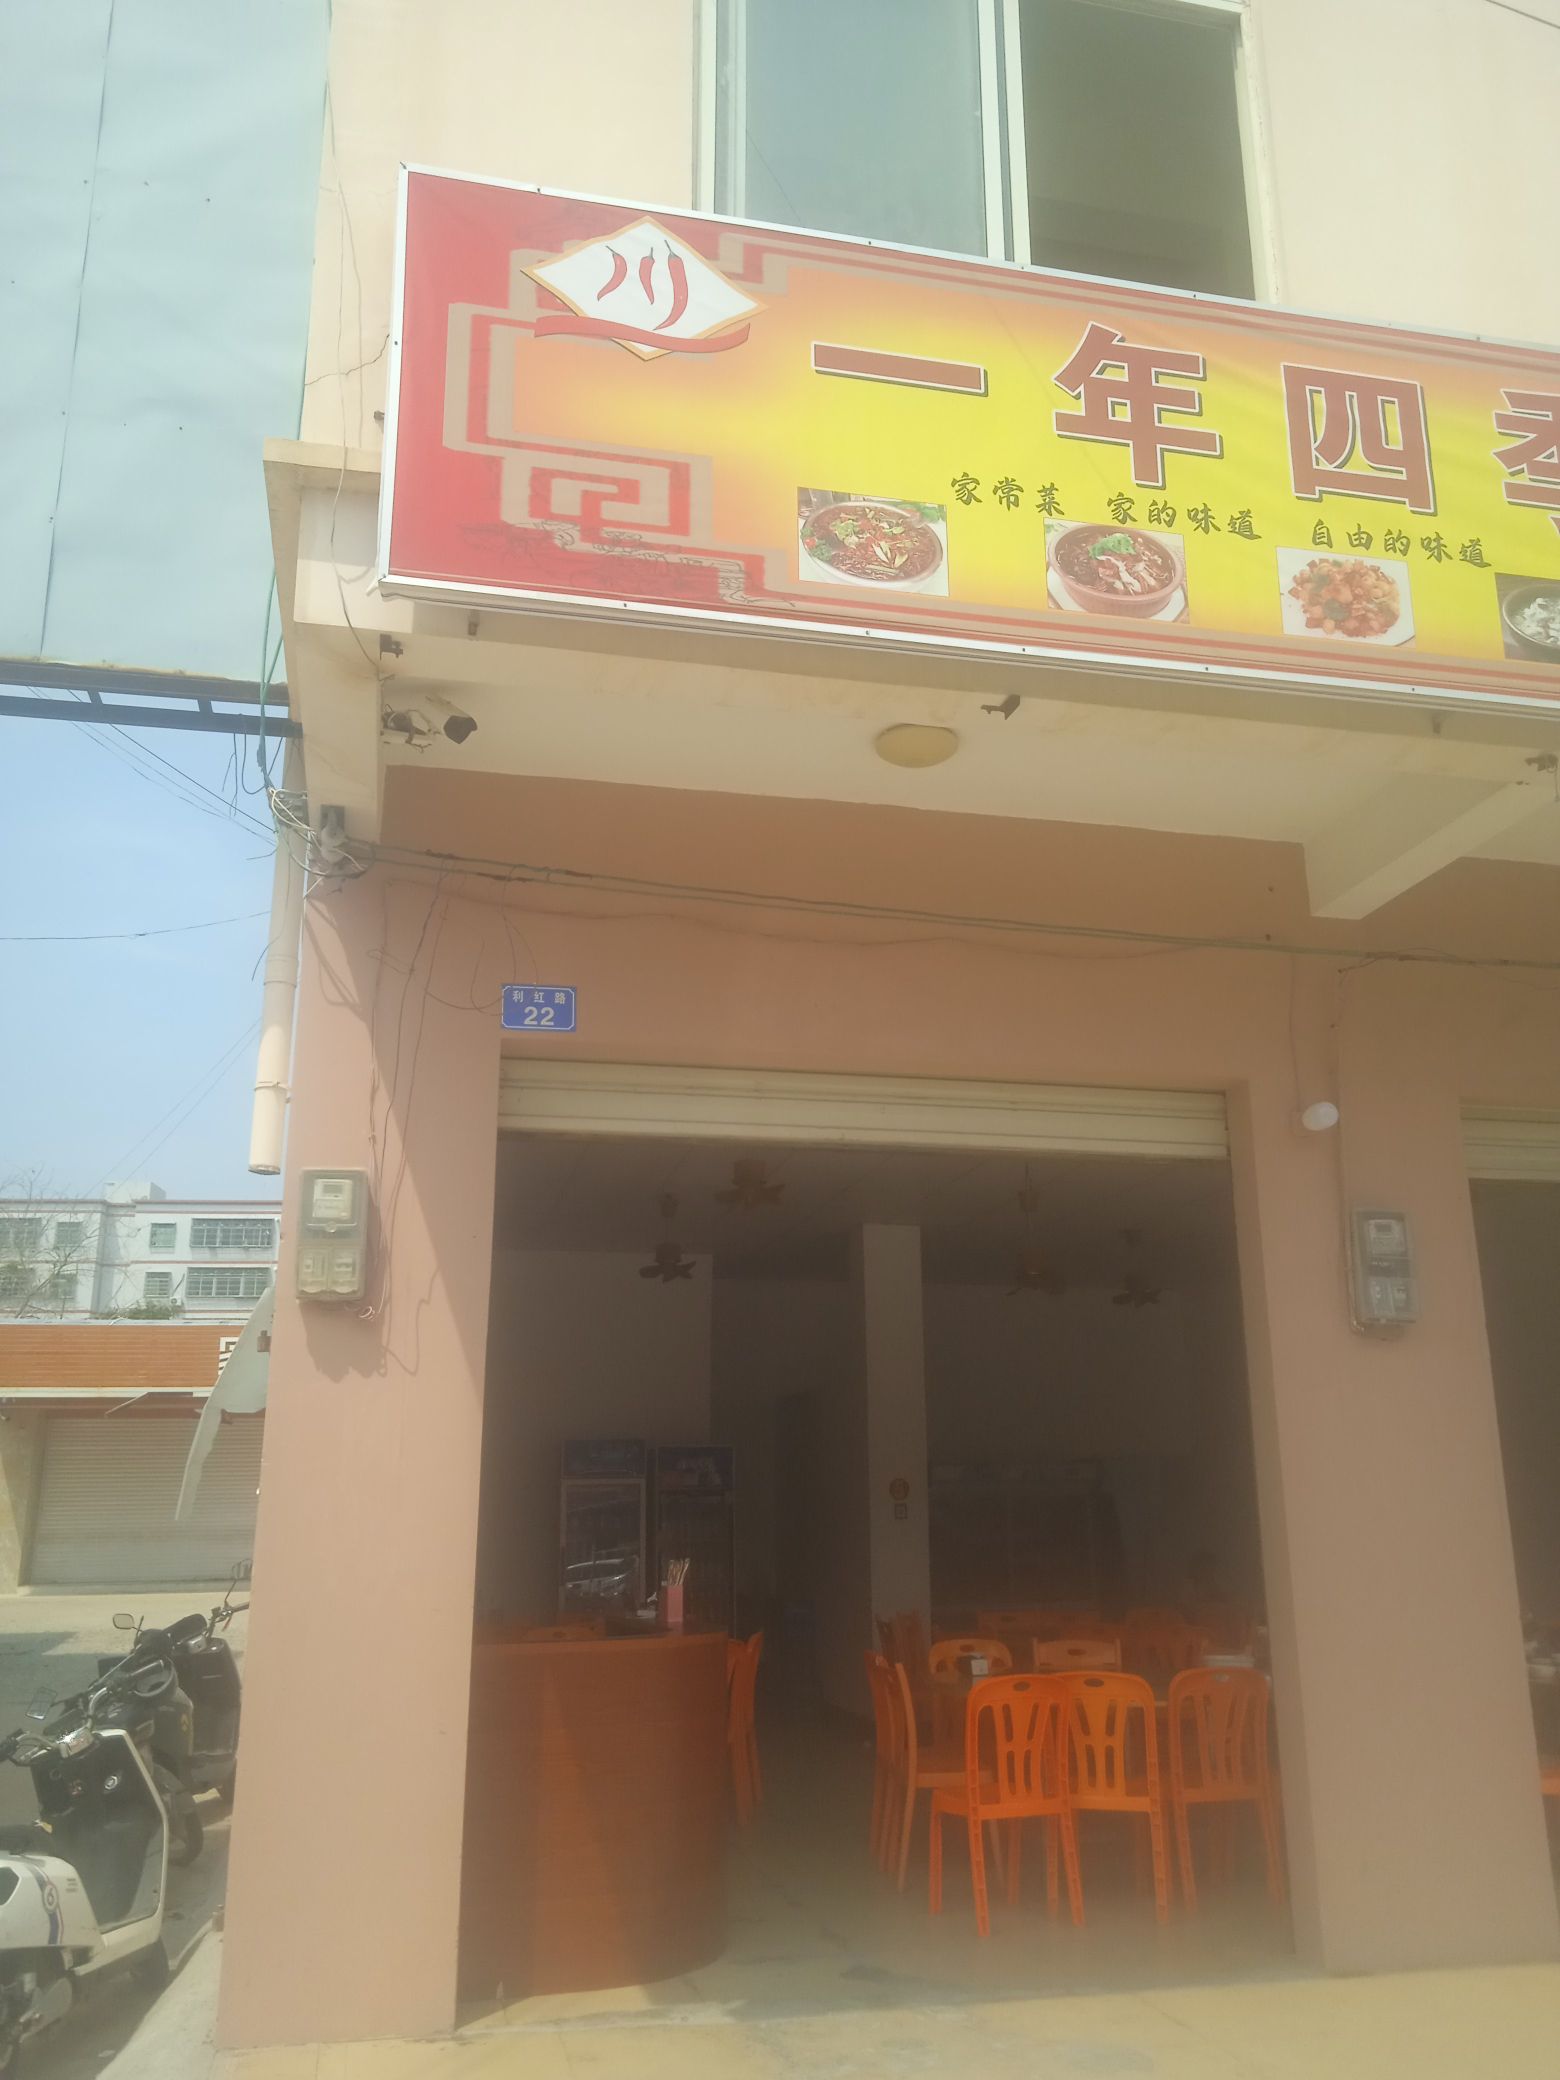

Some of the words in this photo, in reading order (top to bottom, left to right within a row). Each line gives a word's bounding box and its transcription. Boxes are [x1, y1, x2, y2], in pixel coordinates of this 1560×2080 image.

[950, 471, 1065, 517] 家常菜
[1106, 491, 1262, 541] 家的味道
[1311, 518, 1492, 568] 自由的味道
[512, 990, 566, 1005] 利红路
[523, 1006, 555, 1026] 22
